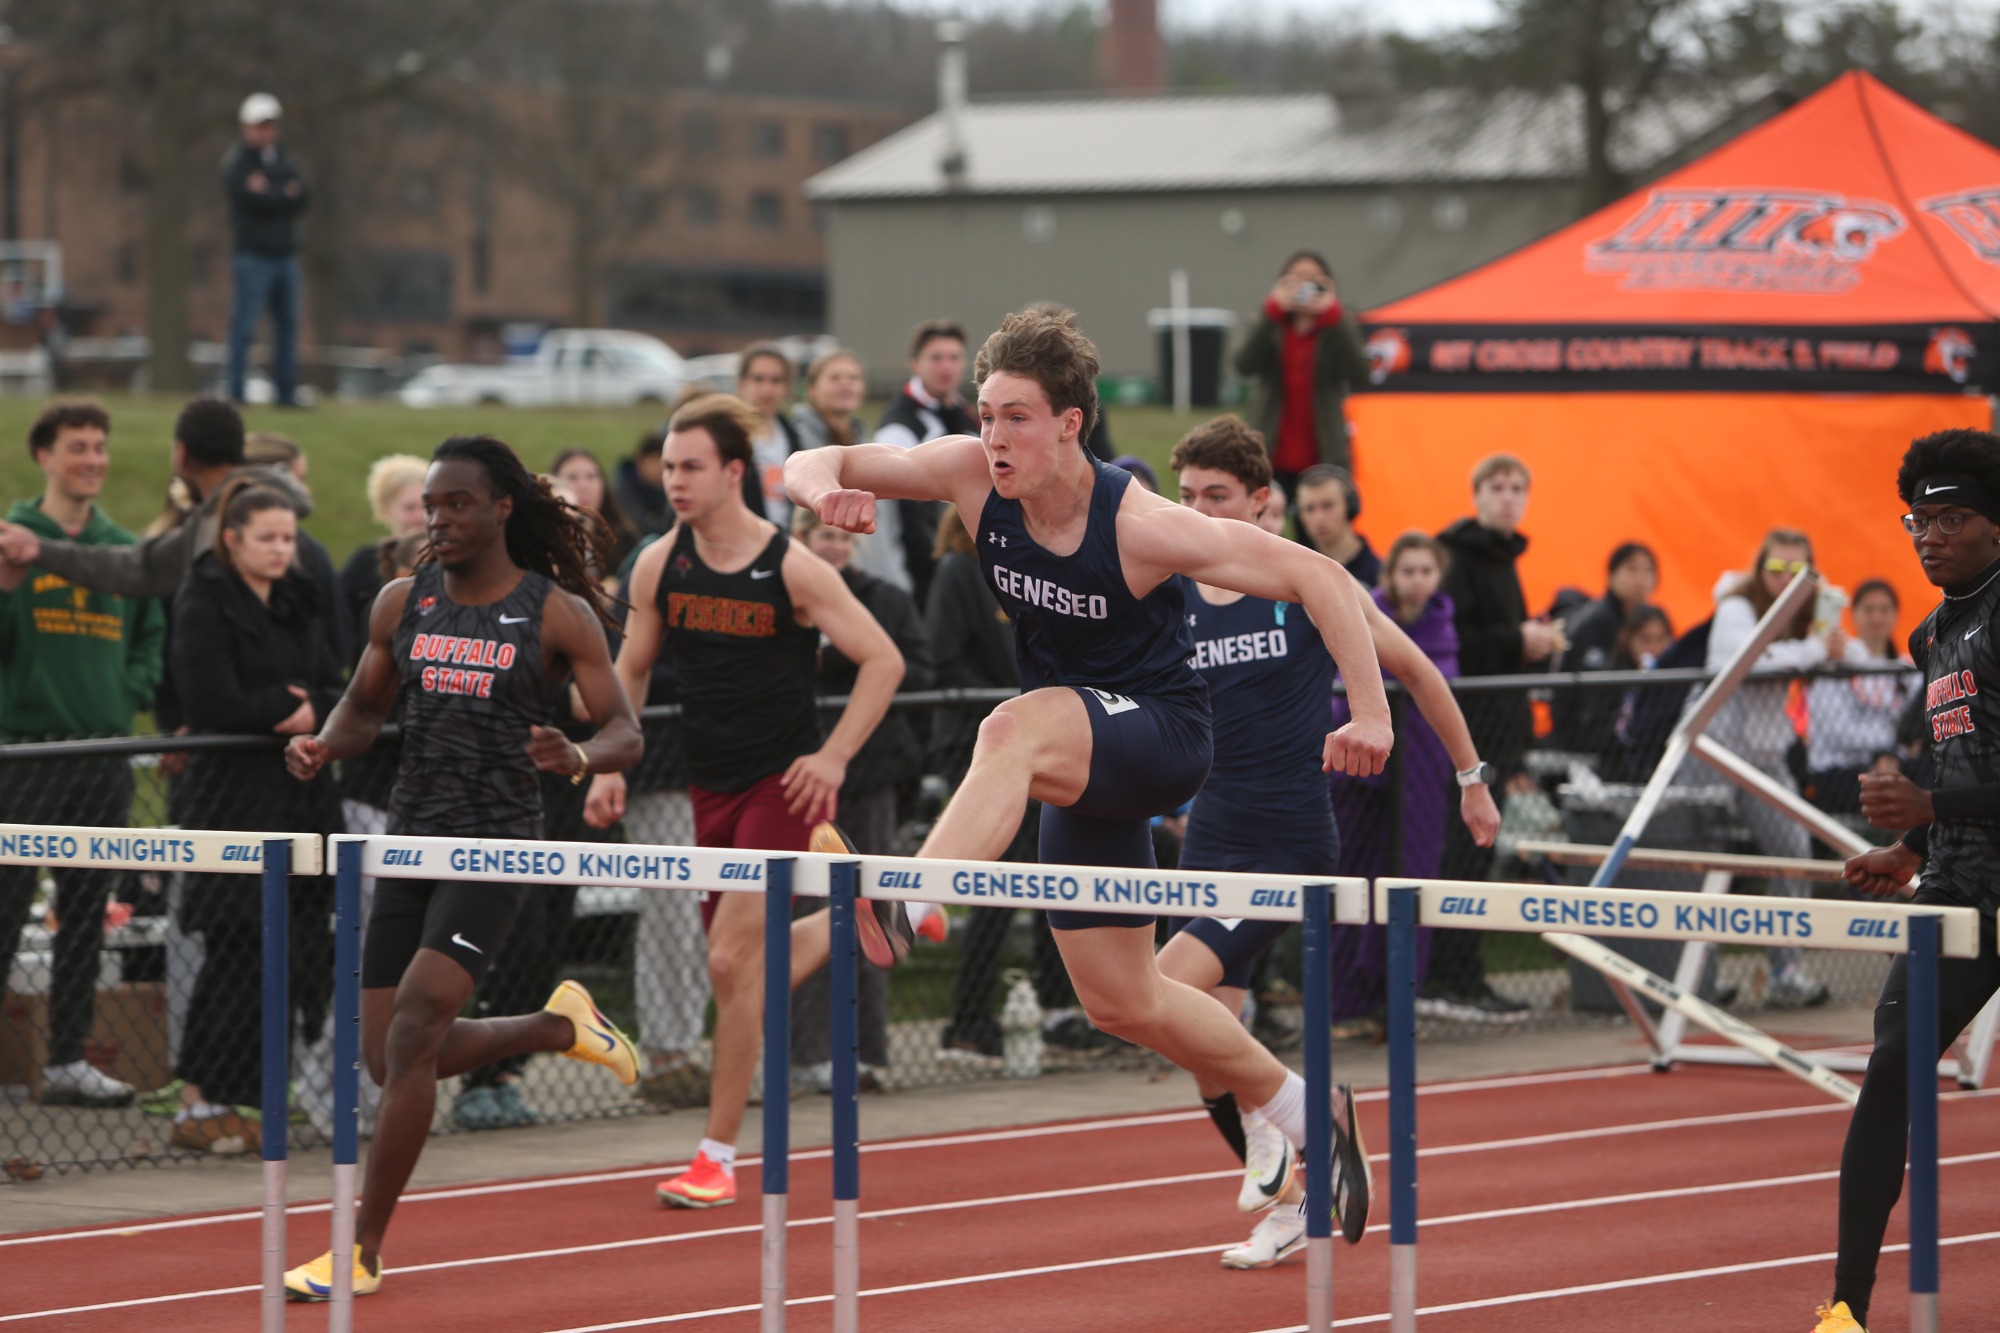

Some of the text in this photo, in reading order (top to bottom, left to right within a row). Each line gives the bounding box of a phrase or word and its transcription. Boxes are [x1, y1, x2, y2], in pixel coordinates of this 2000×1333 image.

[1475, 338, 1561, 372] CROSS
[1565, 336, 1694, 371] COUNTRY
[1700, 338, 1791, 371] TRACK
[1819, 341, 1899, 371] FIELD
[993, 564, 1108, 620] GENESEO
[667, 591, 777, 638] FISHER
[409, 633, 517, 670] BUFFALO
[421, 665, 495, 698] STATE
[1926, 669, 1979, 712] BUFFALO
[1931, 705, 1976, 743] STATE
[89, 836, 196, 864] KNIGHTS
[221, 844, 263, 862] GILL
[382, 848, 763, 881] GILL GENESEO KNIGHTS GILL
[877, 870, 1298, 909] GILL GENESEO KNIGHTS GILL
[1439, 896, 1901, 939] GILL GENESEO KNIGHTS GILL
